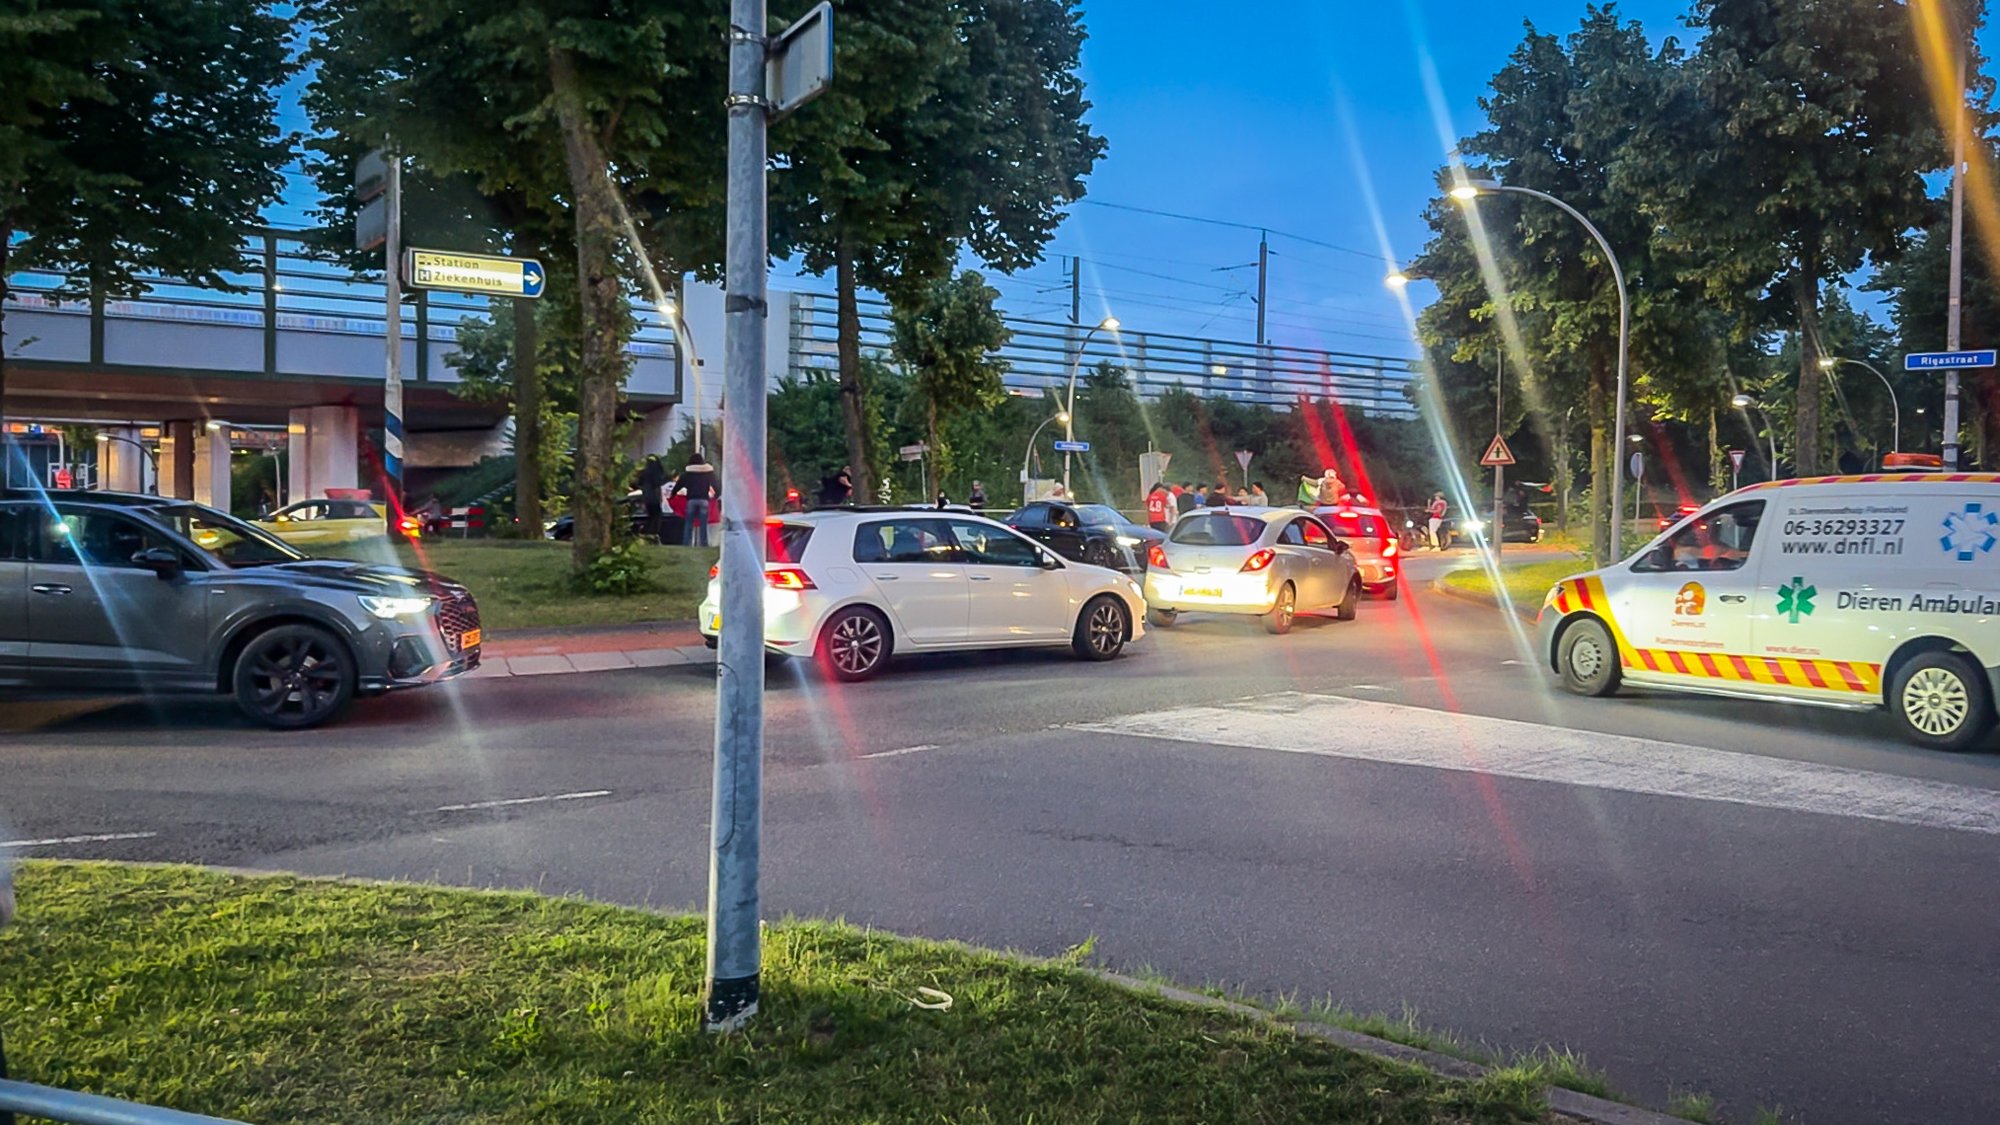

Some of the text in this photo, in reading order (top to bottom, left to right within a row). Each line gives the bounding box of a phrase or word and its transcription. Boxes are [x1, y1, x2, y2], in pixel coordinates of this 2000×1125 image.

[434, 256, 480, 269] Station
[434, 271, 503, 287] Ziekenhuis
[1920, 355, 1978, 366] Rigastraat
[1783, 519, 1906, 536] 06-36293327
[1782, 536, 1904, 555] www.dnfl.nl
[1837, 591, 2000, 616] Dieren Ambula
